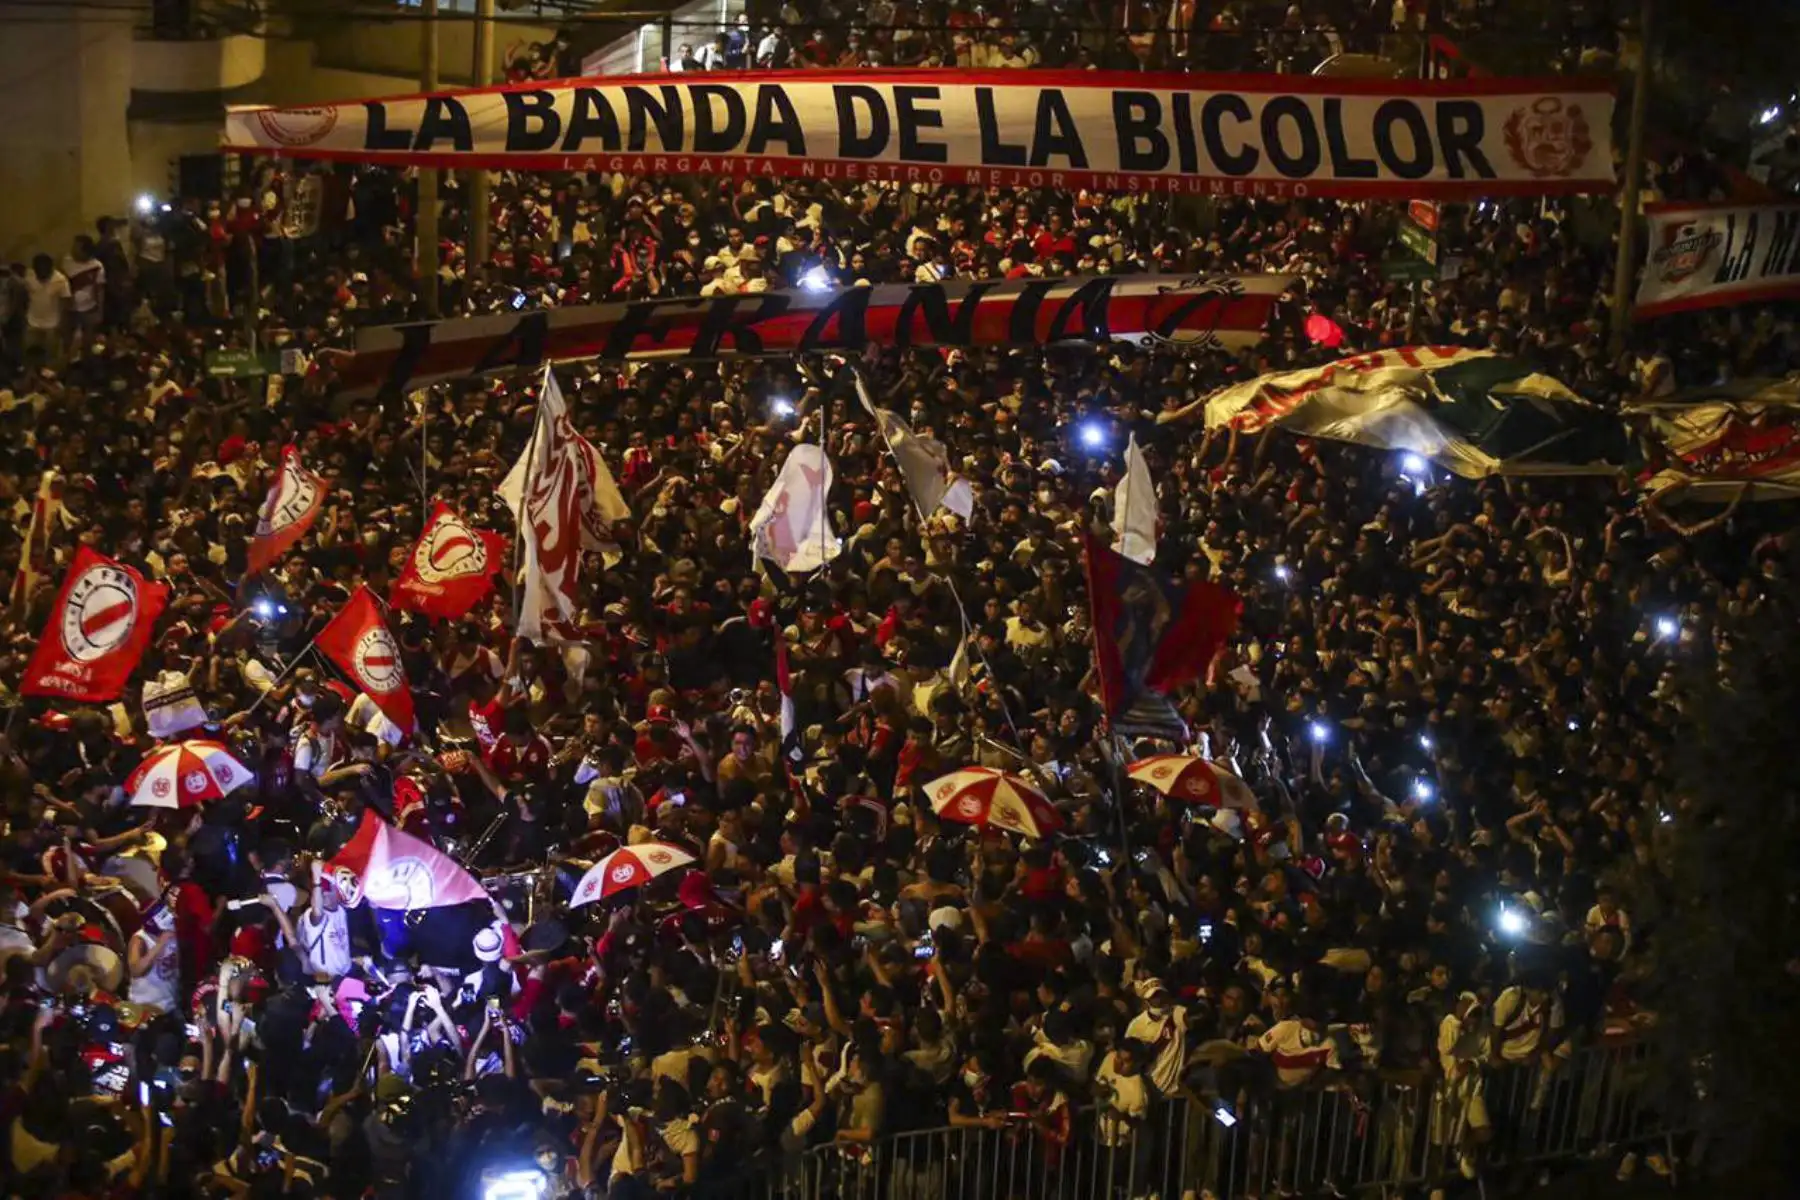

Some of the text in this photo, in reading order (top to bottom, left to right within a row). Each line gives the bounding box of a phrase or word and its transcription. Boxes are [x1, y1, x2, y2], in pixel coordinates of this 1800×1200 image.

[365, 97, 473, 151] LA
[505, 84, 806, 155] BANDA
[832, 85, 948, 162] DE
[975, 88, 1089, 168] LA
[1112, 91, 1497, 179] BICOLOR
[802, 164, 942, 182] NUESTRO
[966, 171, 1064, 187] MEJOR
[1092, 174, 1308, 196] INSTRUMENTO
